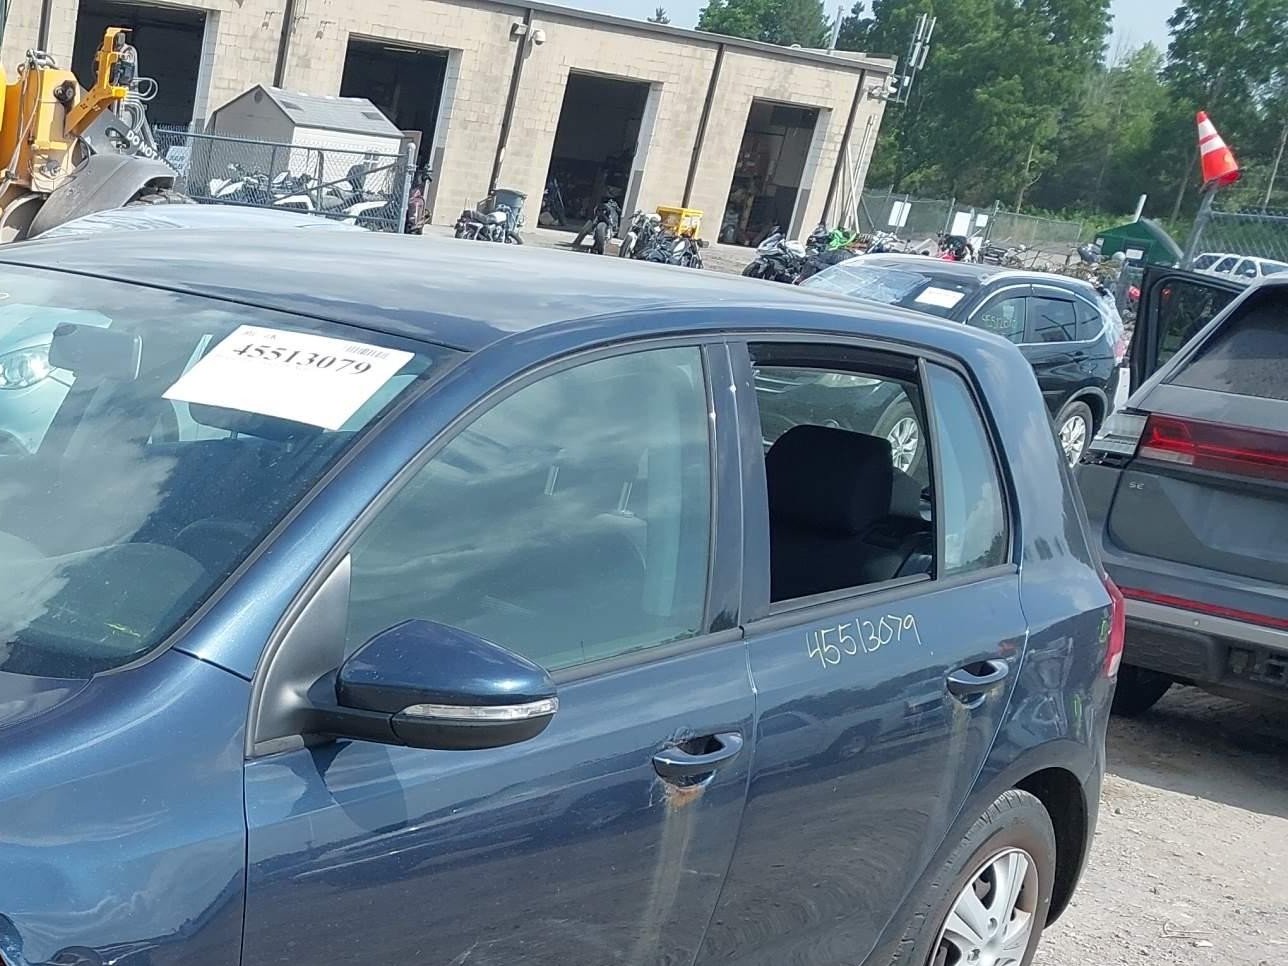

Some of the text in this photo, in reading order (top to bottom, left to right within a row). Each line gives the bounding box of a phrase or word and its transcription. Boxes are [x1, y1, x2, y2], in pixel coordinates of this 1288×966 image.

[126, 129, 141, 146] DO
[139, 141, 158, 160] NOT
[232, 343, 372, 376] 45513079
[805, 613, 923, 672] 45513079
